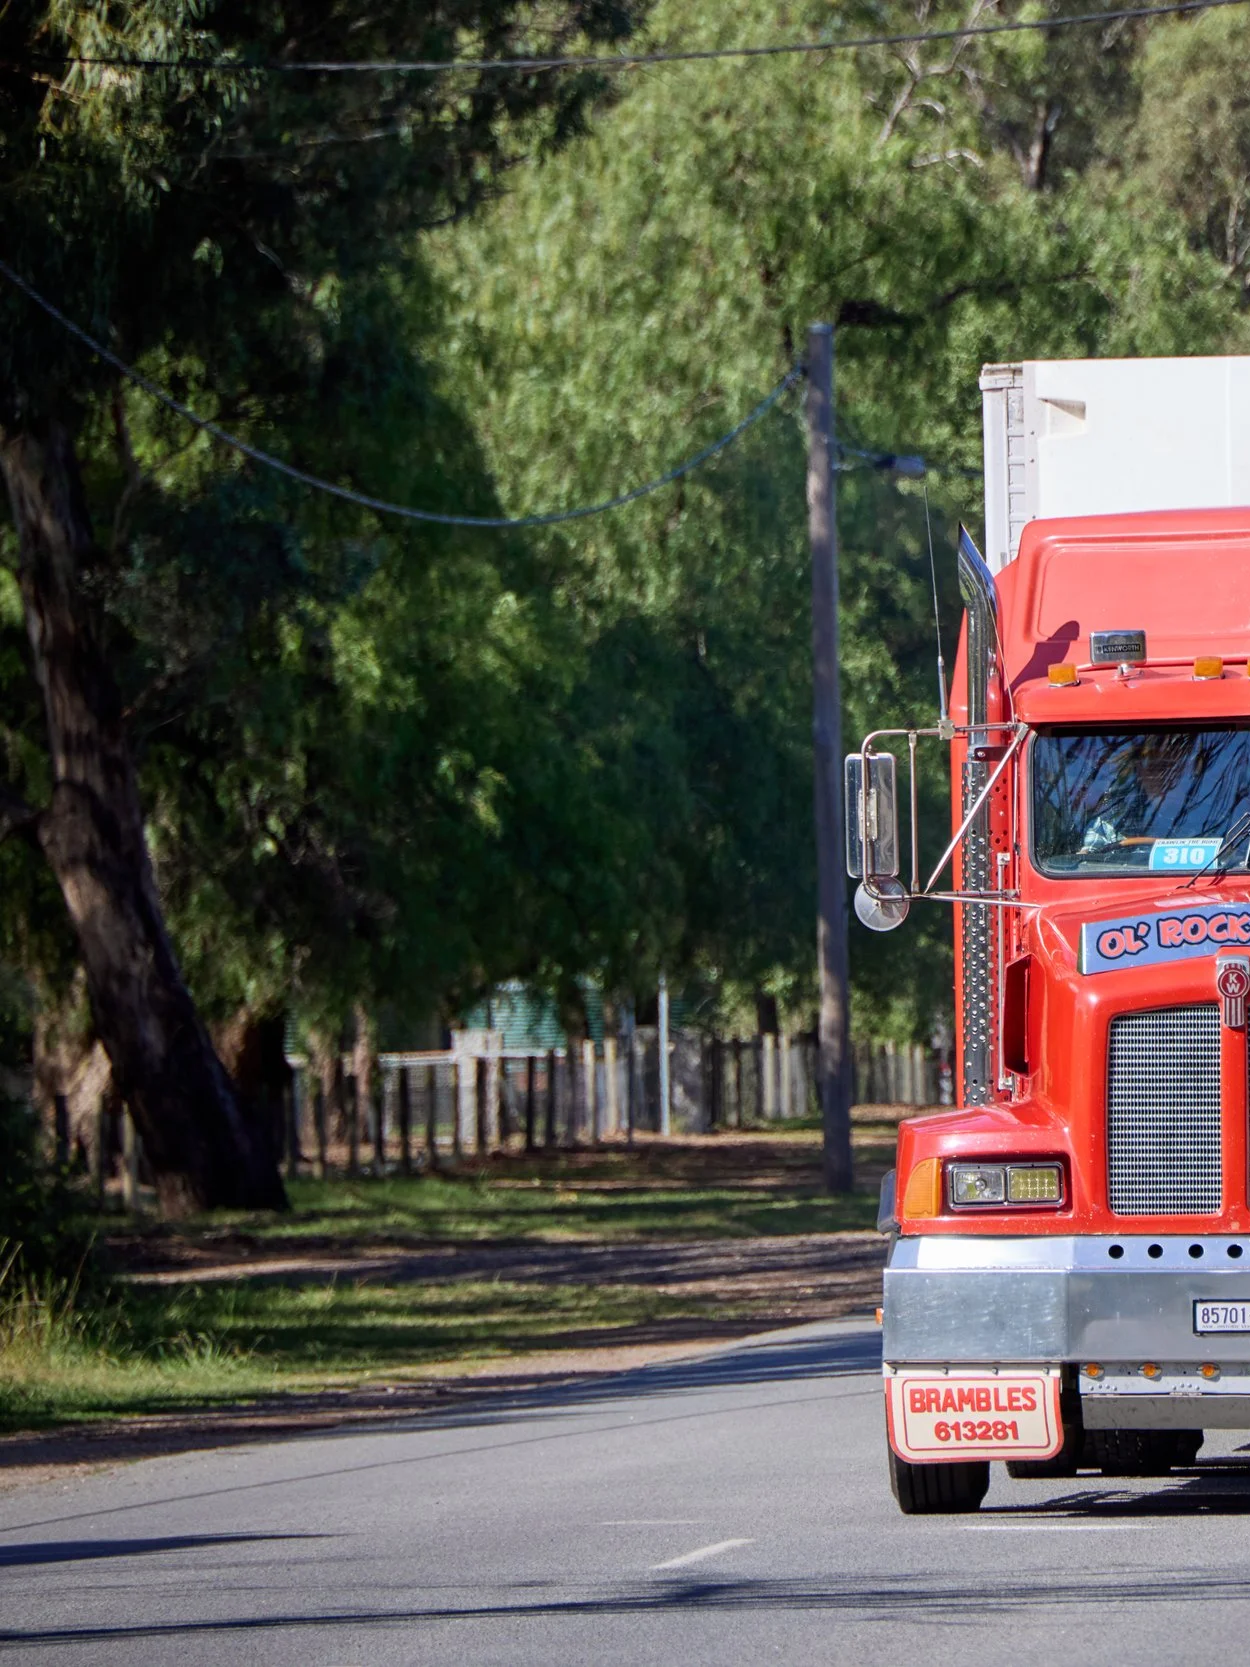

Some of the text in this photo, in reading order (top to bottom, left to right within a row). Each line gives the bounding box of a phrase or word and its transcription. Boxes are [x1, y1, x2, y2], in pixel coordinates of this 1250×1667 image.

[1163, 847, 1205, 865] 310
[1097, 922, 1150, 960] OL'
[1201, 1307, 1246, 1324] 85701
[910, 1387, 1037, 1413] BRAMBLES
[934, 1420, 1019, 1441] 613281
